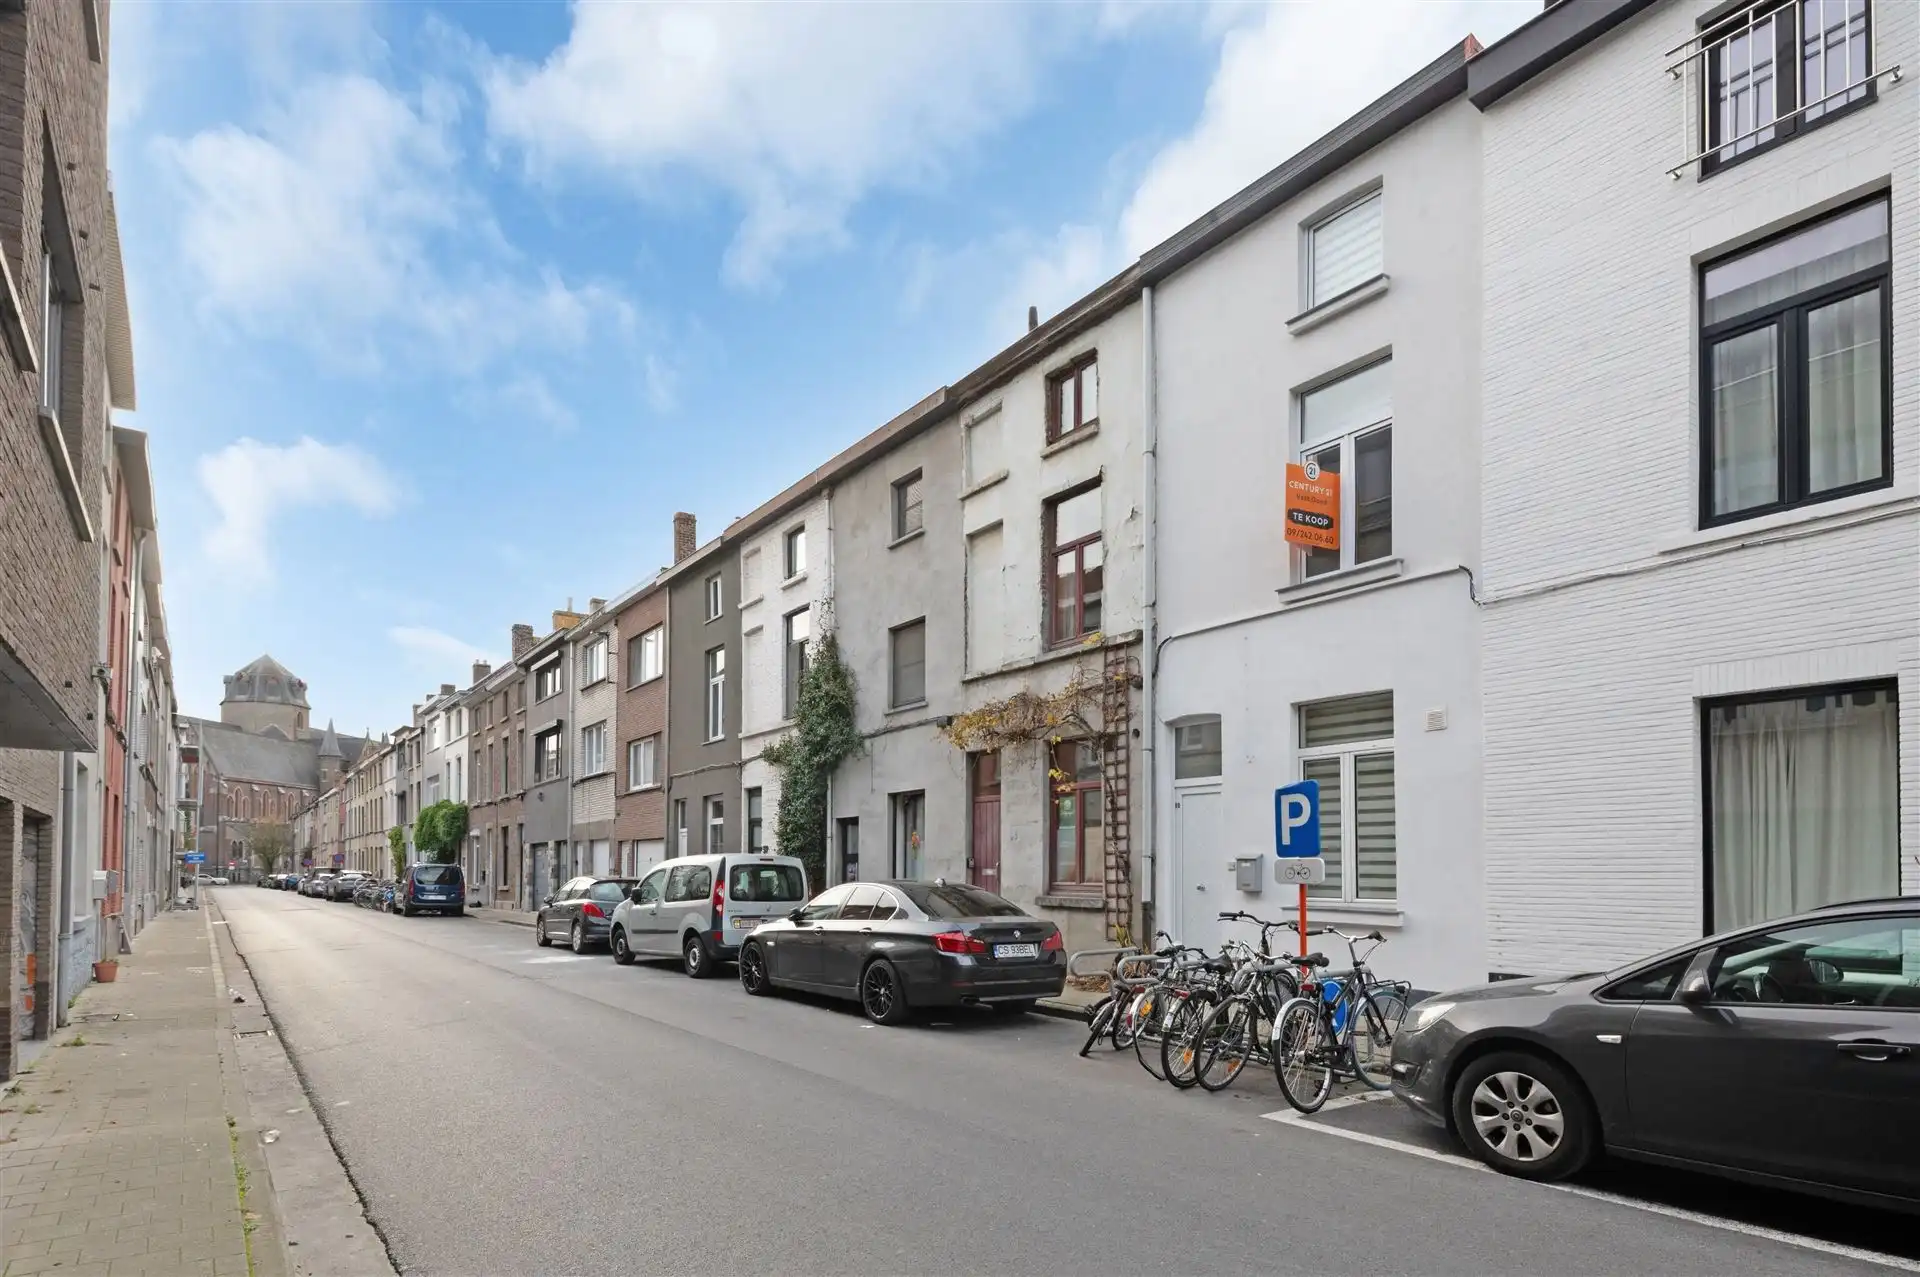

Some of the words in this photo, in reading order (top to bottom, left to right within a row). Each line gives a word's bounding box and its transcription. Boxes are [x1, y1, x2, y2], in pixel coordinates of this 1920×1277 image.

[1288, 481, 1325, 494] CENTURY
[1293, 512, 1303, 521] TE
[1305, 515, 1329, 526] KOOP
[1280, 793, 1311, 845] P
